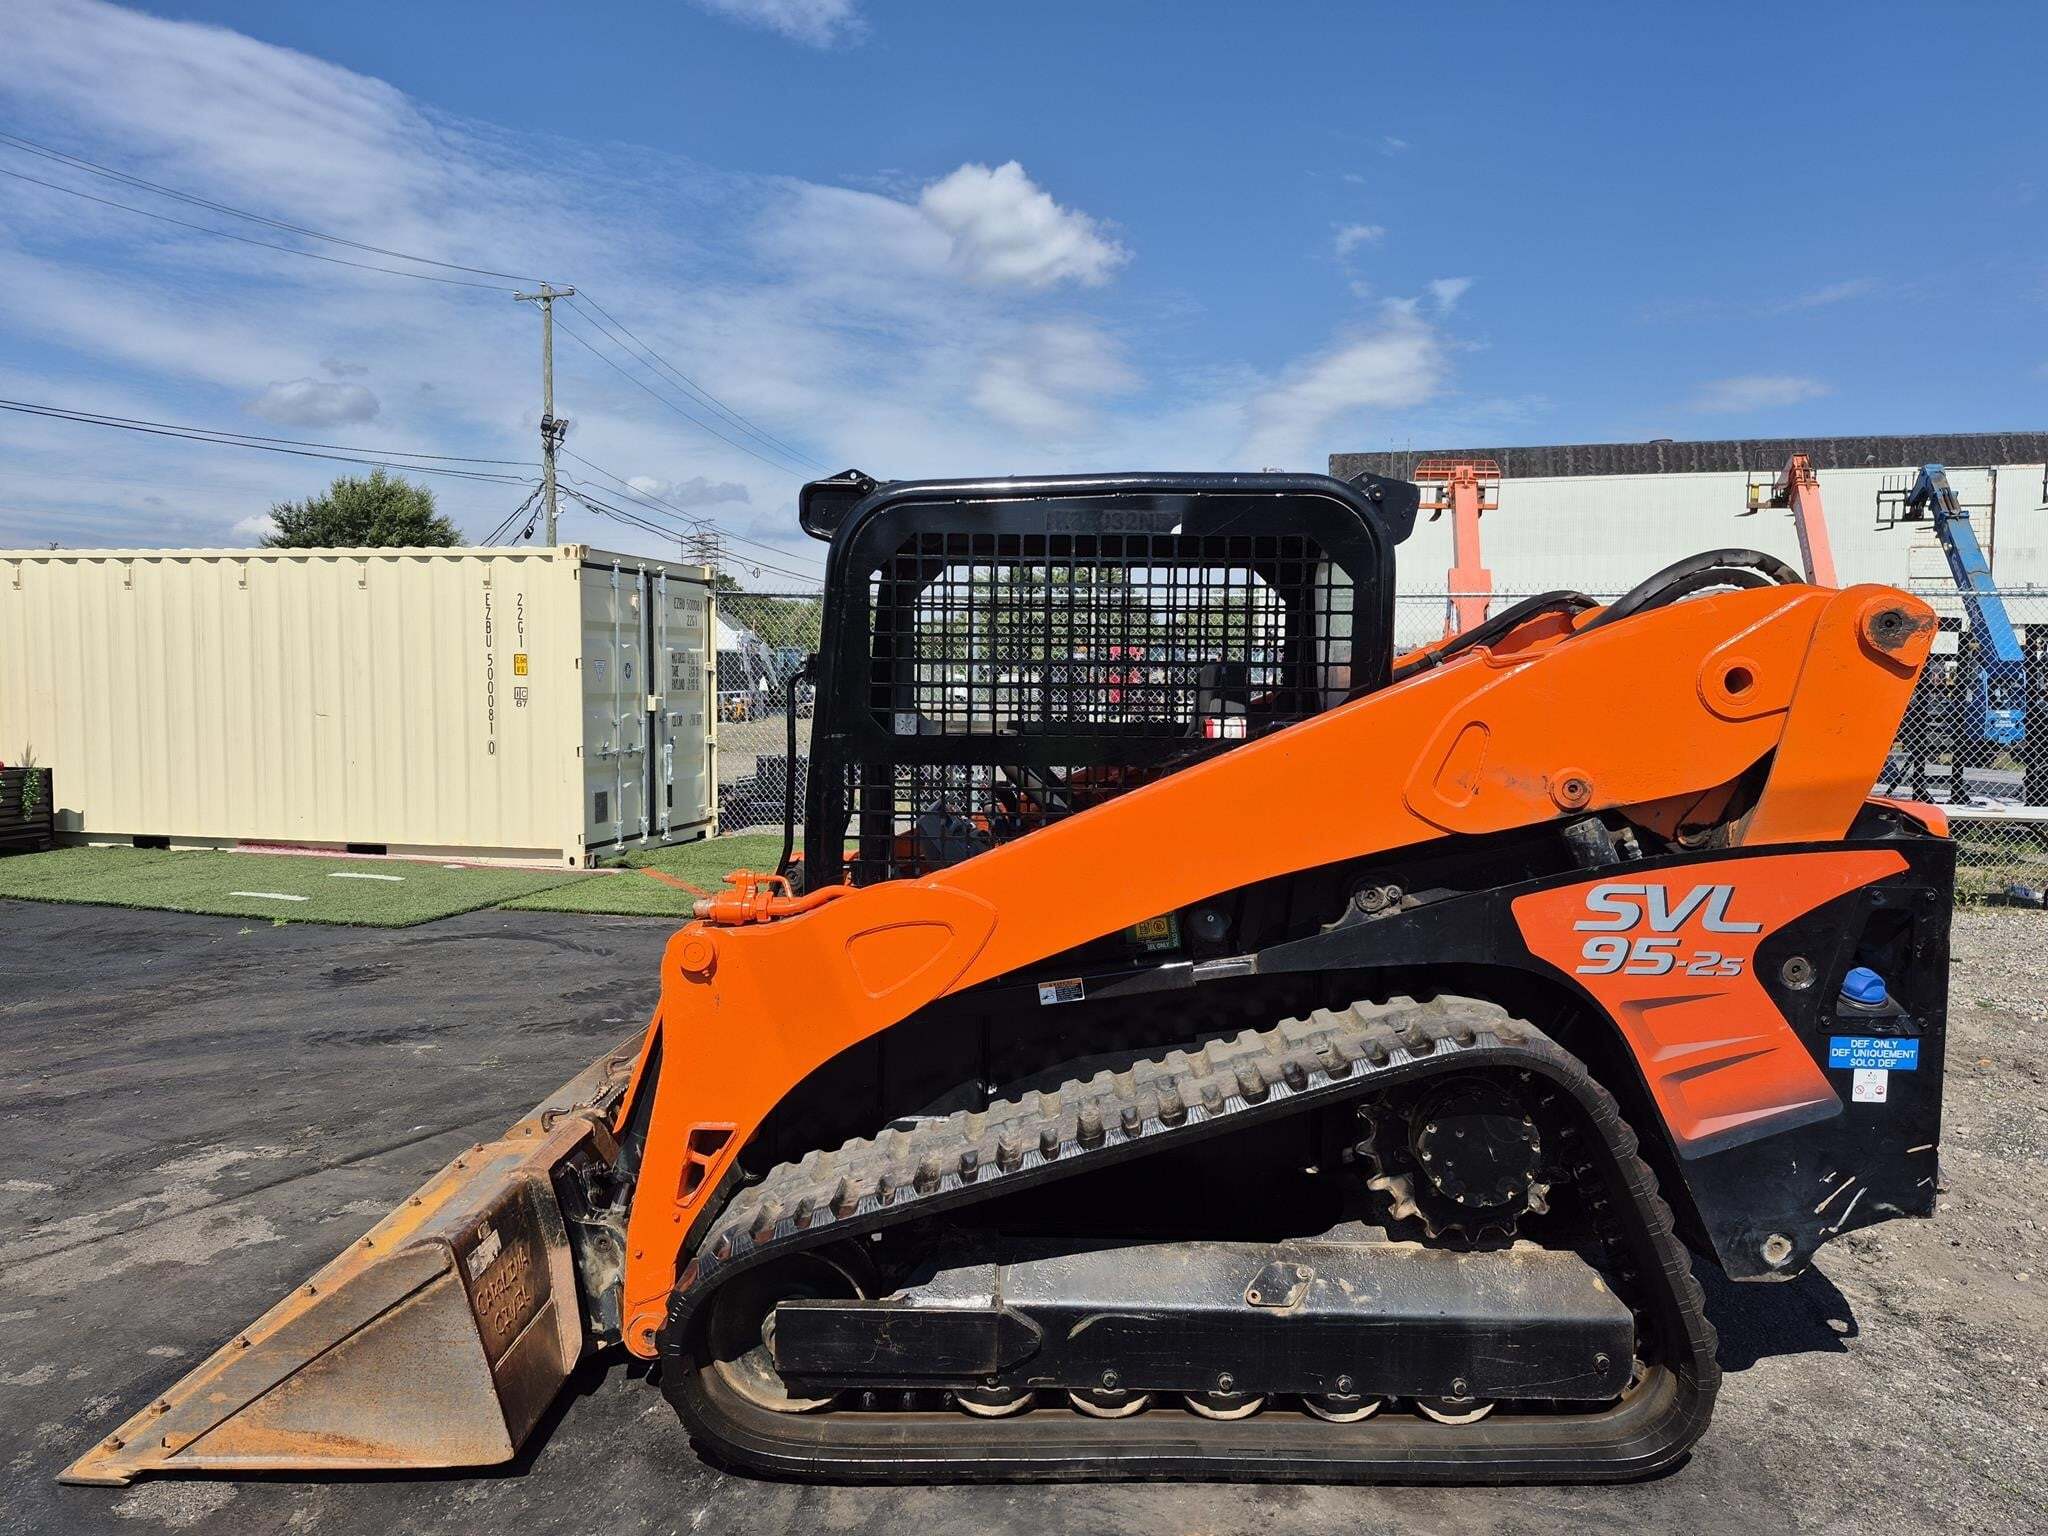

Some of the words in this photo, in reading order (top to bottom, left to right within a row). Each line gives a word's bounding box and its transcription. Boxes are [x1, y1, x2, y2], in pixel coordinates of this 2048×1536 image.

[516, 700, 527, 708] 87
[489, 741, 495, 755] 0
[1573, 883, 1764, 934] SVL
[1850, 1039, 1870, 1048] DEF
[1873, 1040, 1898, 1049] ONLY
[1831, 1048, 1851, 1057] DEF
[1853, 1049, 1916, 1059] UNIQUEMENT
[1850, 1058, 1875, 1067] SOLO
[1878, 1058, 1897, 1067] DEF
